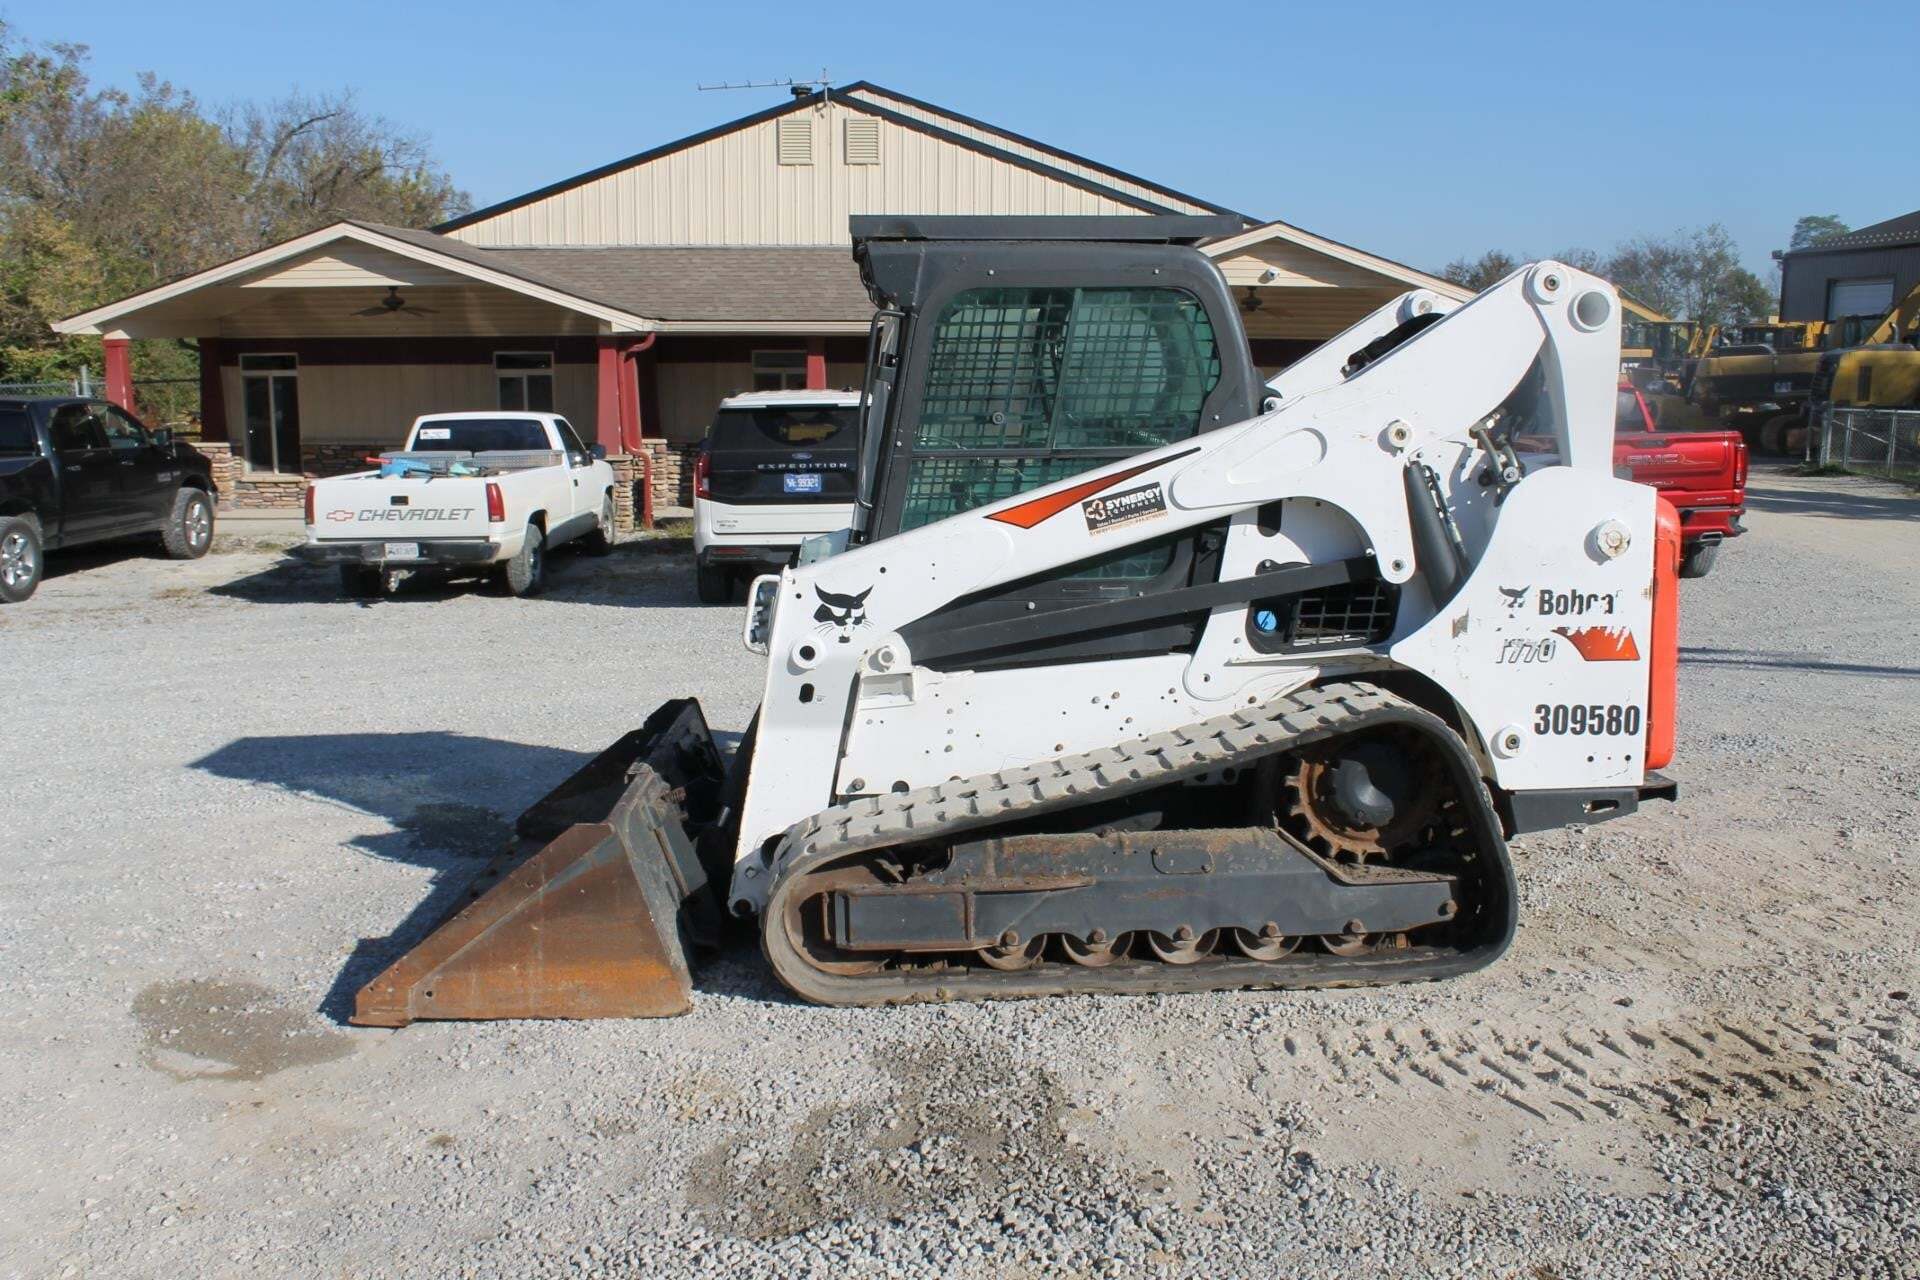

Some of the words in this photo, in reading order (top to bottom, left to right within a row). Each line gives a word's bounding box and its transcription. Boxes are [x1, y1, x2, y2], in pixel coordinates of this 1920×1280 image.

[757, 462, 848, 470] EXPEDITION
[1626, 453, 1680, 465] GMC
[1105, 486, 1161, 510] SYNERGY
[1107, 497, 1161, 516] EQUIPMENT
[357, 508, 475, 522] CHEVROLET
[1534, 704, 1641, 736] 309580
